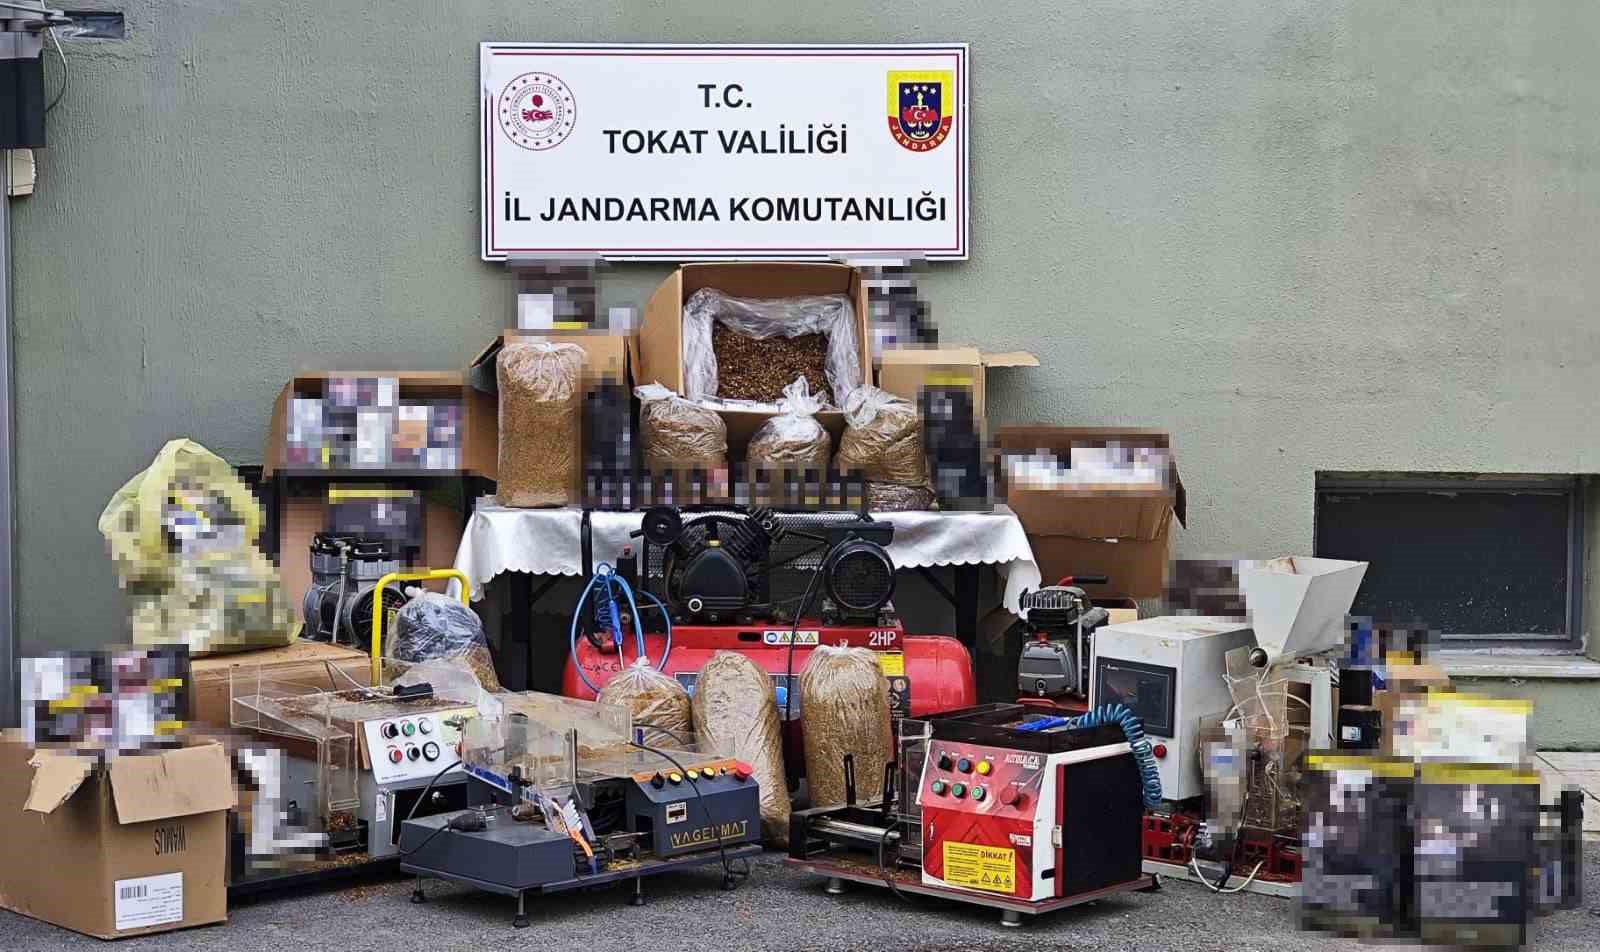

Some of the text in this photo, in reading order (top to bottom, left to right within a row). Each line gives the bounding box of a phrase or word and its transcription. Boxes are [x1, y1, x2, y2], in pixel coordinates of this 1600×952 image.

[698, 84, 752, 109] T.C.
[603, 124, 847, 154] TOKAT VALİLİĞİ
[892, 125, 949, 150] JANDARMA
[504, 191, 946, 222] İL JANDARMA KOMUTANLIĞI
[869, 631, 896, 646] 2HP
